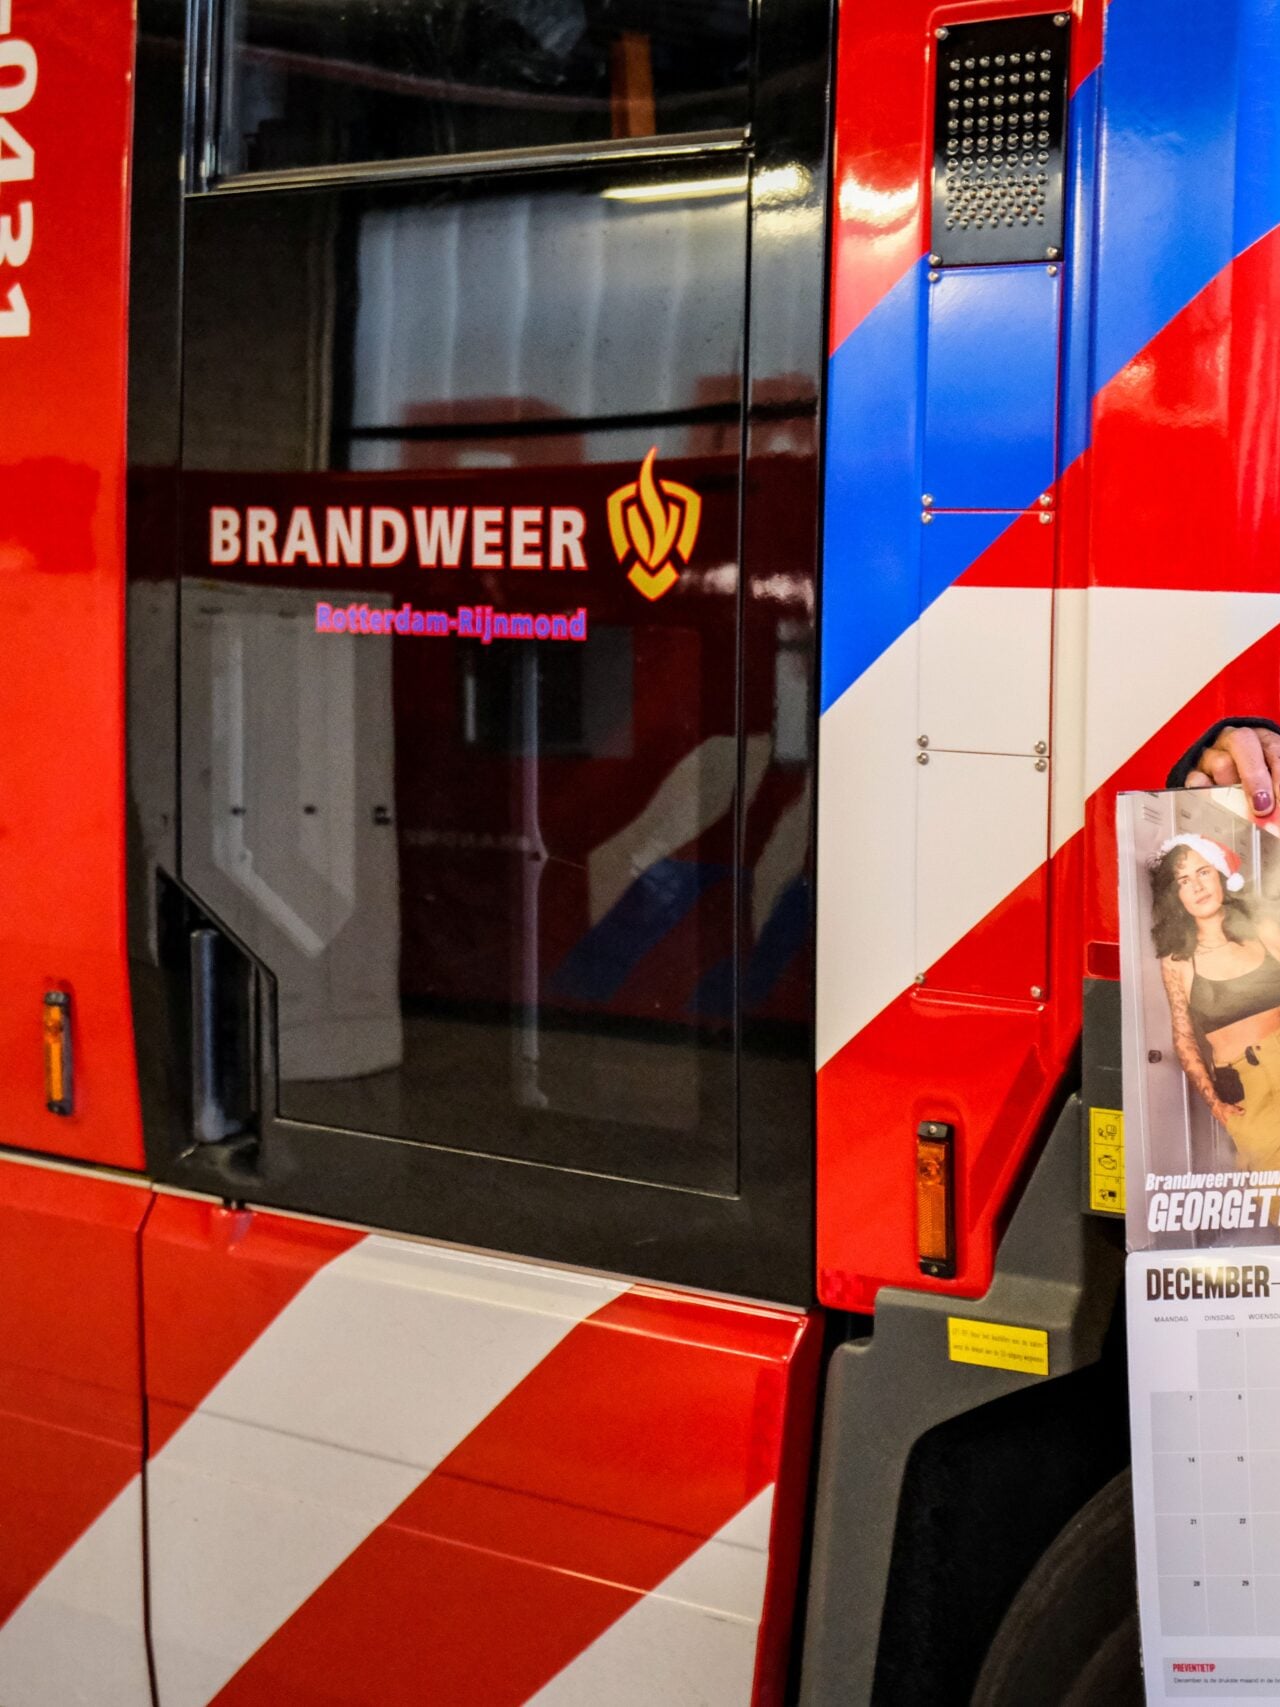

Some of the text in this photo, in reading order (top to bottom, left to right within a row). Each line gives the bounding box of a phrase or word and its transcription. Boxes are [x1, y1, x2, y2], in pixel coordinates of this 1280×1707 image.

[210, 506, 588, 570] BRANDWEER
[316, 602, 587, 644] Rotterdam-Rijnmond
[1154, 1315, 1189, 1323] MAANDAG
[1172, 1663, 1216, 1673] PREVENTIETIP
